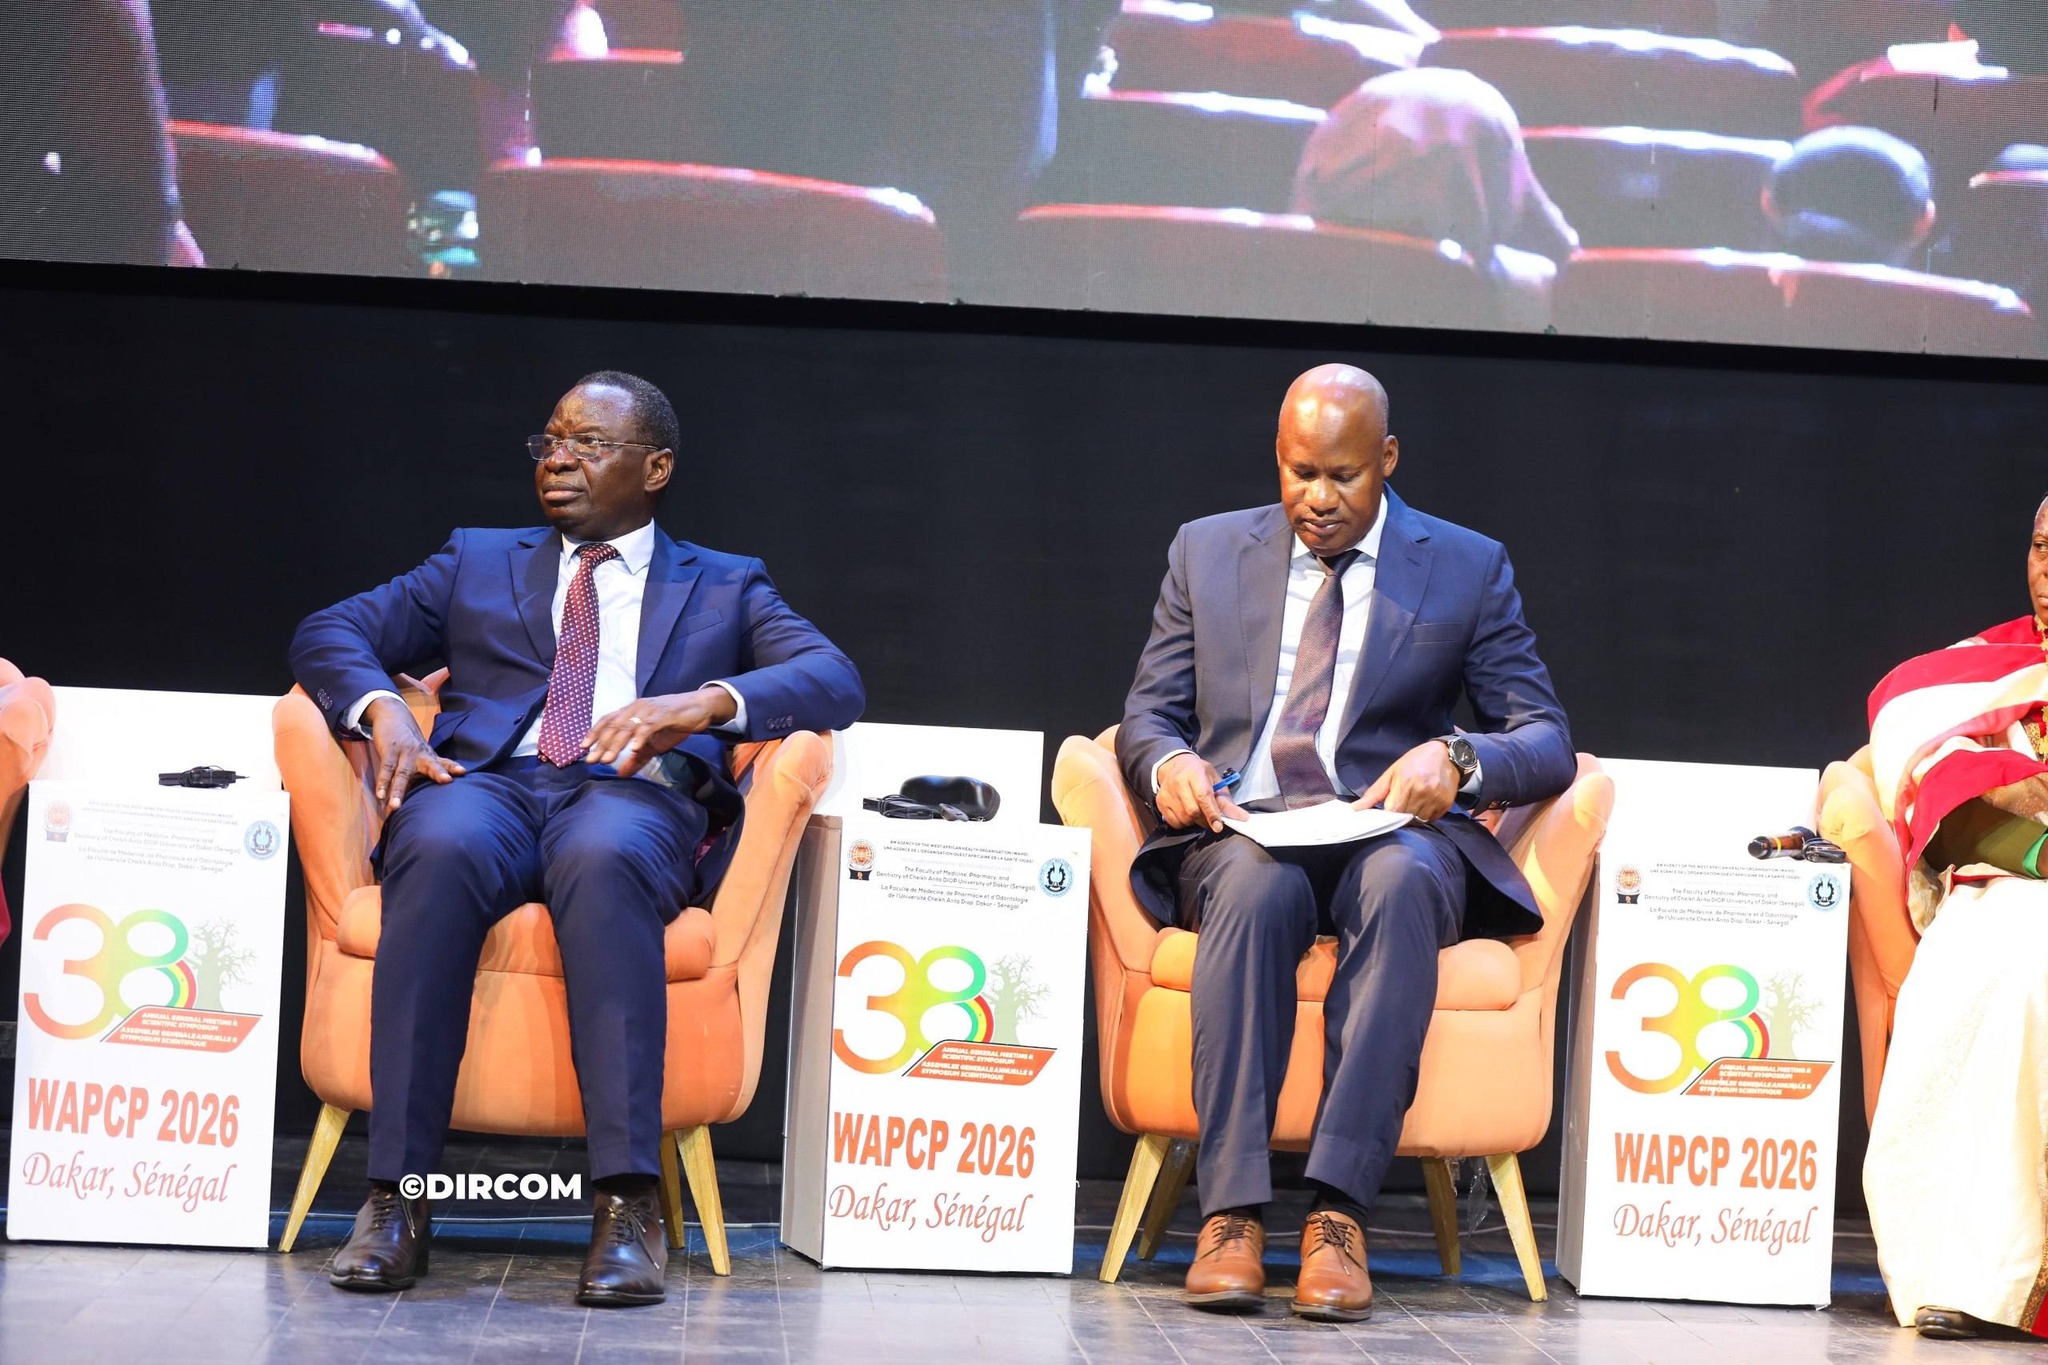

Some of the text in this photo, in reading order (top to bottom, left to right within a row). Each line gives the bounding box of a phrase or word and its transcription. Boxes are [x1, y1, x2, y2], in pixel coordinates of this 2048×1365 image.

[24, 903, 197, 1040] 38
[833, 940, 994, 1074] 38
[1605, 962, 1769, 1095] 38
[28, 1078, 240, 1148] WAPCP 2026
[834, 1112, 1036, 1178] WAPCP 2026
[23, 1150, 237, 1213] Dakar, Sénégal
[1614, 1132, 1818, 1191] WAPCP 2026
[829, 1182, 1033, 1243] Dakar, Sénégal
[1613, 1200, 1818, 1256] Dakar, Sénégal
